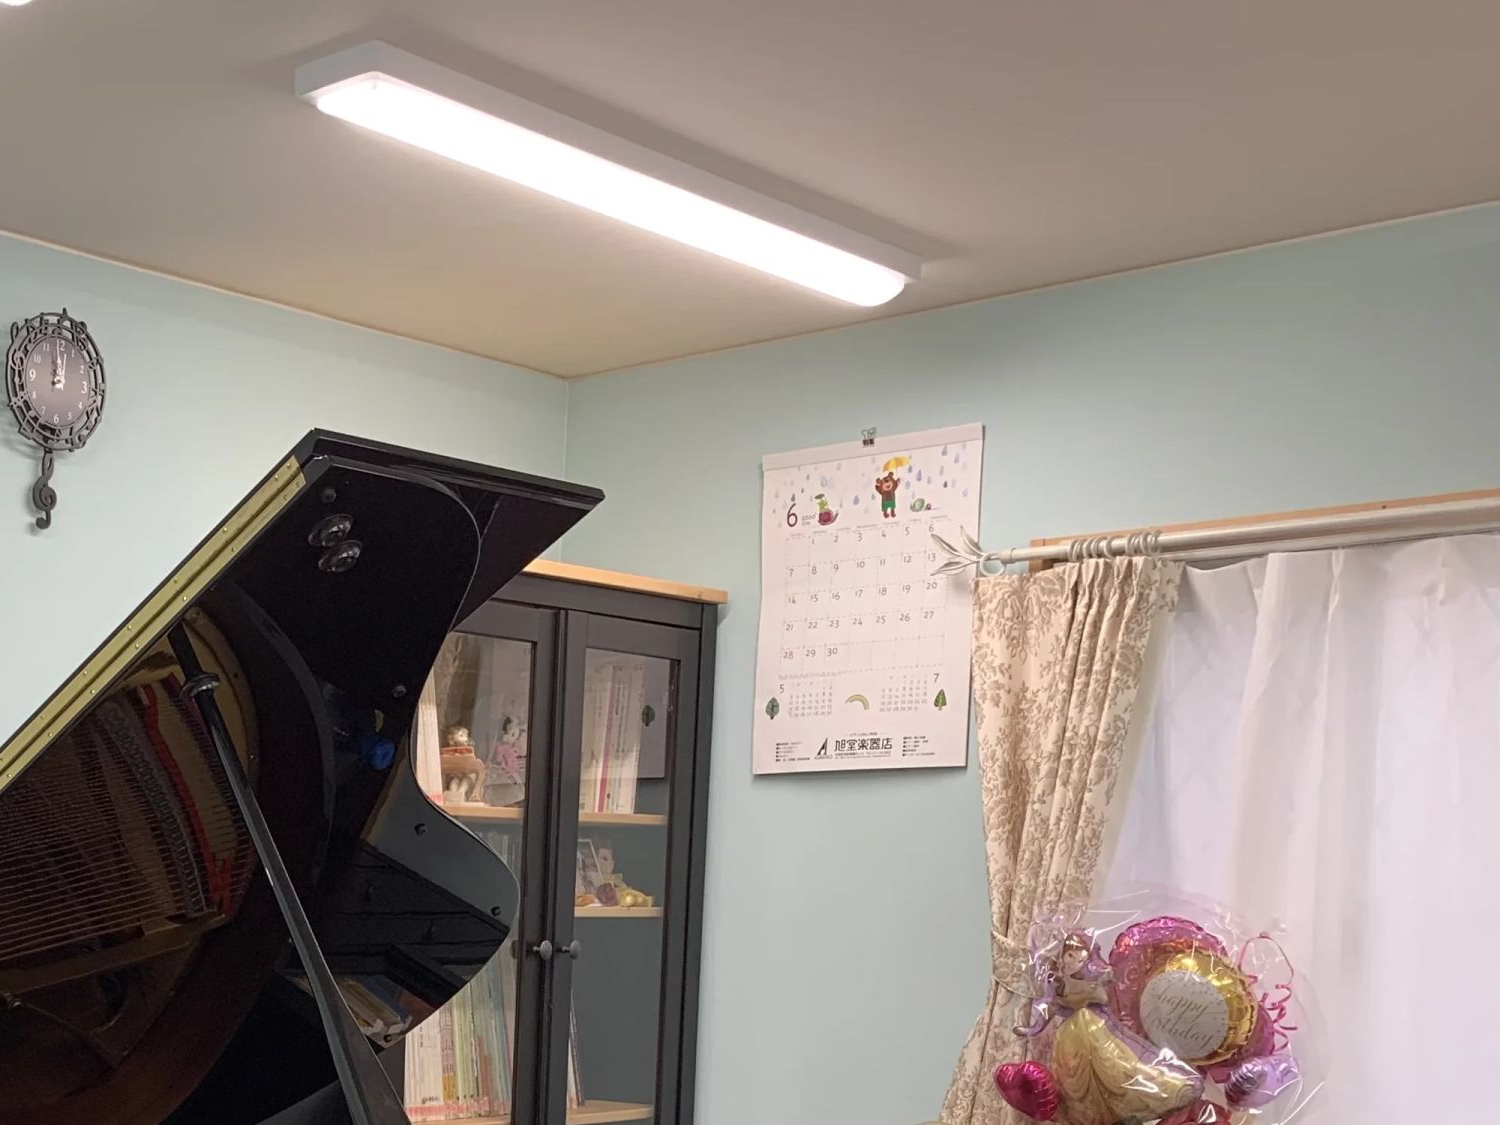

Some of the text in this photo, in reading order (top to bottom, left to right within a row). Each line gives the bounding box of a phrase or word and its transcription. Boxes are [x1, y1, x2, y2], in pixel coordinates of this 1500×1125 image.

[787, 503, 798, 527] 6
[856, 561, 865, 569] 10
[927, 553, 936, 562] 13
[810, 594, 818, 602] 15
[832, 592, 840, 600] 16
[855, 589, 863, 597] 17
[878, 587, 887, 596] 18
[902, 584, 911, 593] 19
[926, 582, 937, 590] 20
[807, 621, 818, 629] 22
[829, 620, 840, 628] 23
[852, 617, 863, 626] 24
[875, 616, 886, 624] 25
[899, 613, 911, 622] 26
[923, 611, 934, 619] 27
[783, 648, 838, 660] 28 29 30
[933, 673, 940, 683] 7
[779, 684, 785, 694] 5
[834, 737, 893, 752] 旭堂楽器店
[1150, 984, 1216, 1023] happy
